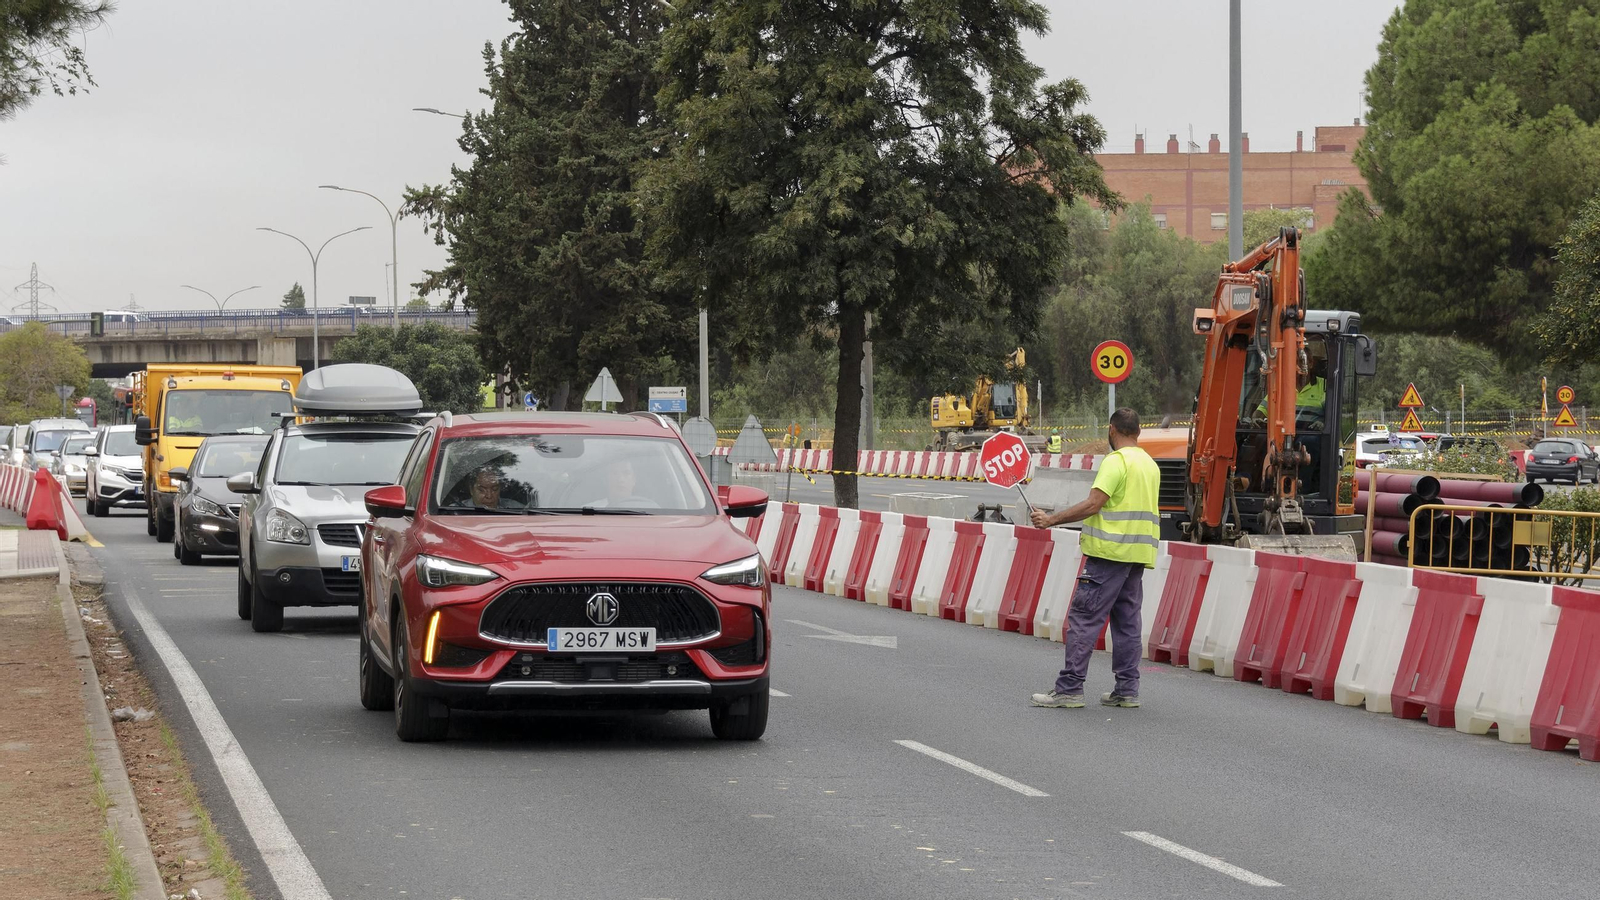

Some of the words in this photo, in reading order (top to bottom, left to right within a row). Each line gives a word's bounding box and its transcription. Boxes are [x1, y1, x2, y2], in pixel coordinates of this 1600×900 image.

[1100, 355, 1125, 369] 30
[985, 443, 1023, 478] STOP
[590, 596, 616, 622] MG
[564, 632, 609, 648] 2967
[616, 632, 649, 648] MSW
